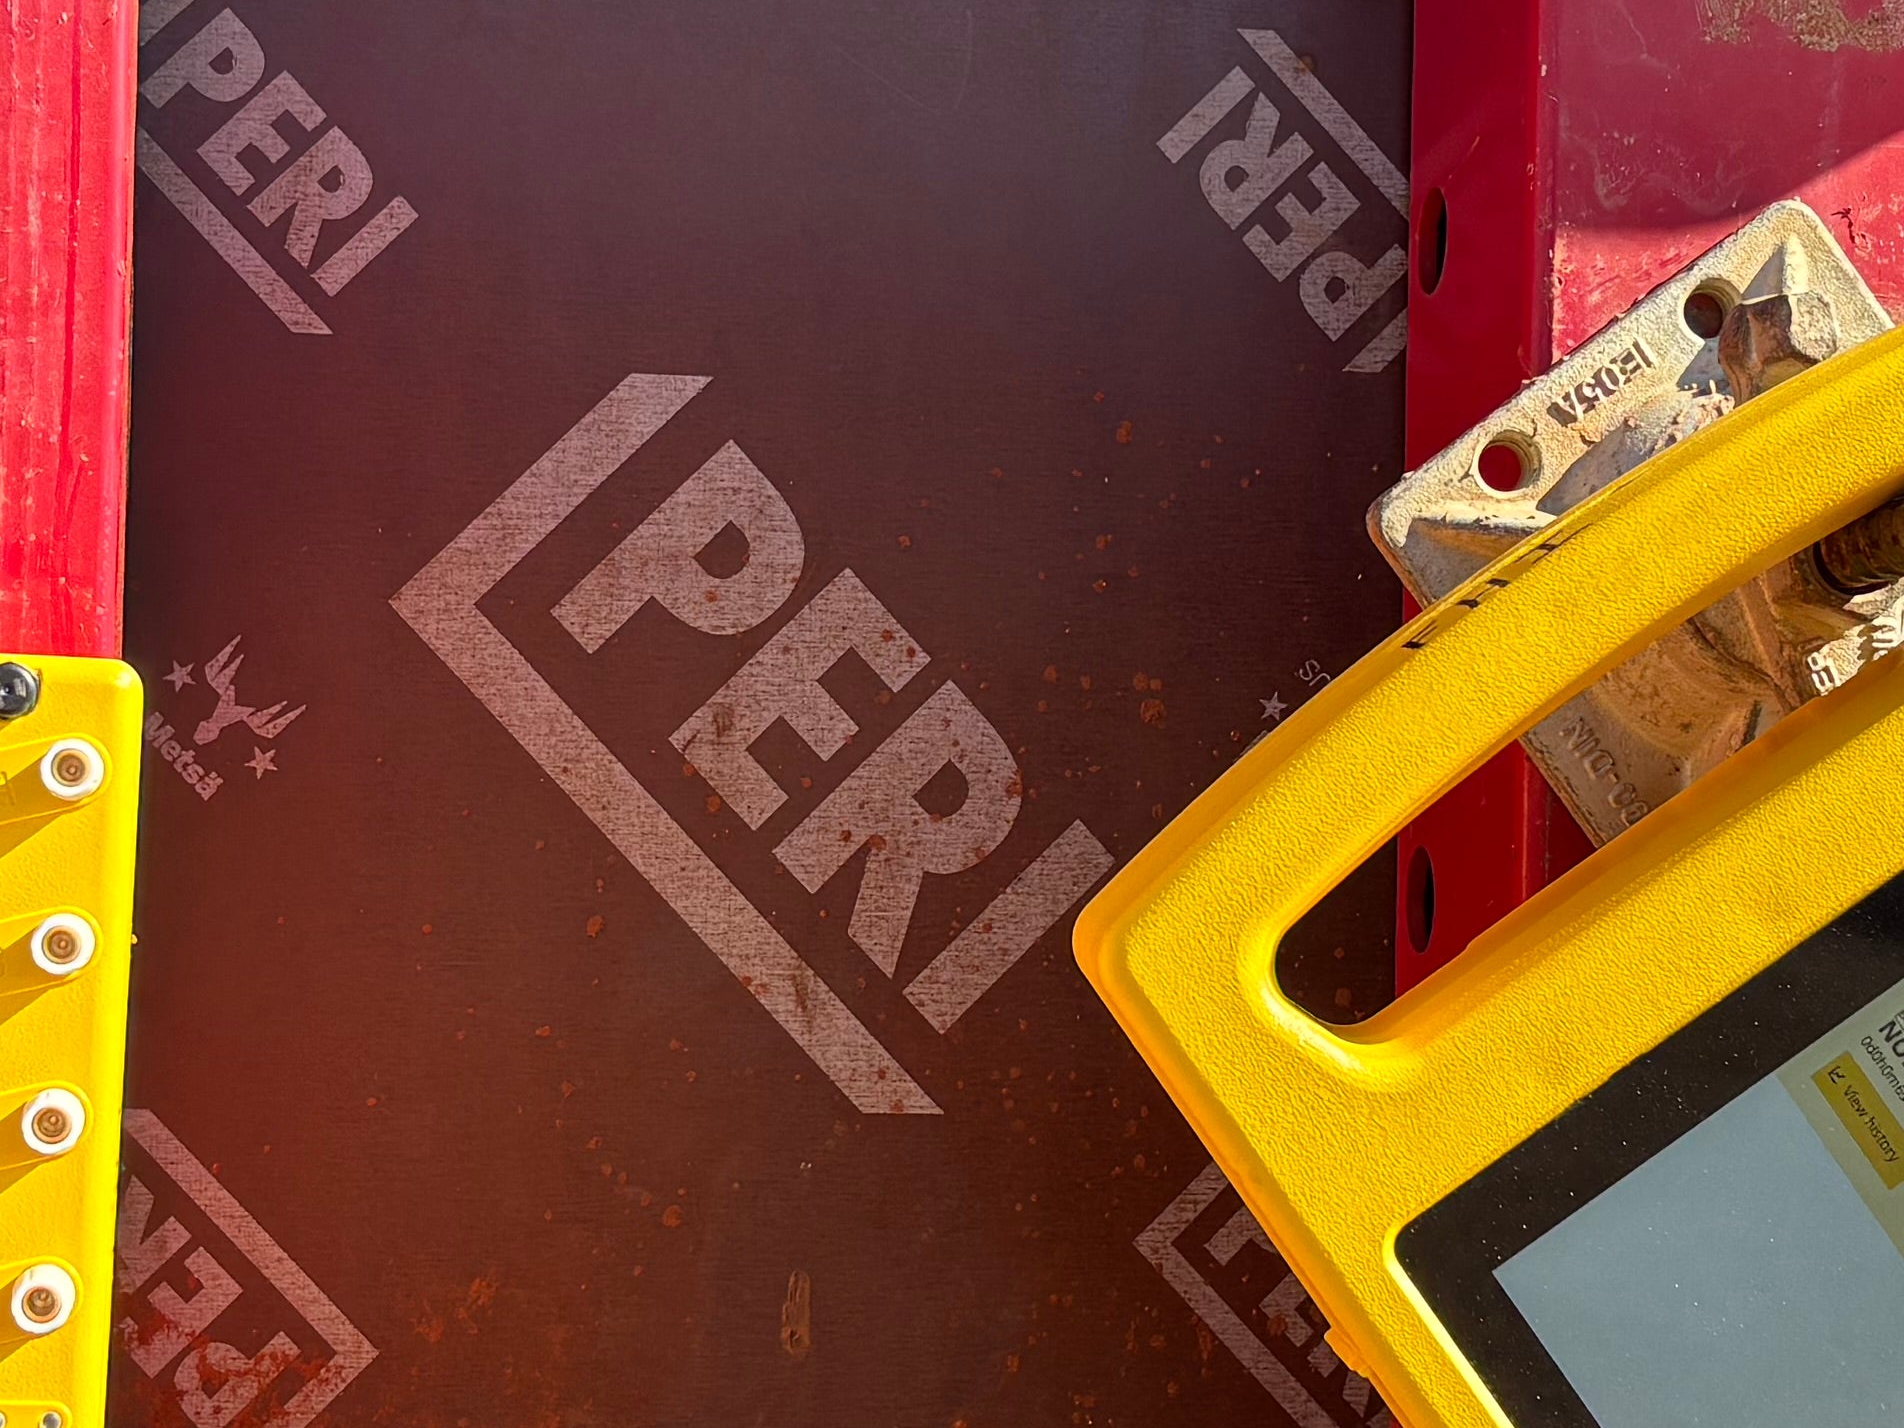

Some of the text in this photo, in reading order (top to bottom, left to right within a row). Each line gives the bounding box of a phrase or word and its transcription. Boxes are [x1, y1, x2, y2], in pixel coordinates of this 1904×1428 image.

[139, 6, 419, 298] PERI
[1156, 65, 1409, 343] PERI
[143, 710, 225, 802] Metsä
[549, 438, 1116, 1034] PERI
[1842, 1083, 1900, 1163] View history
